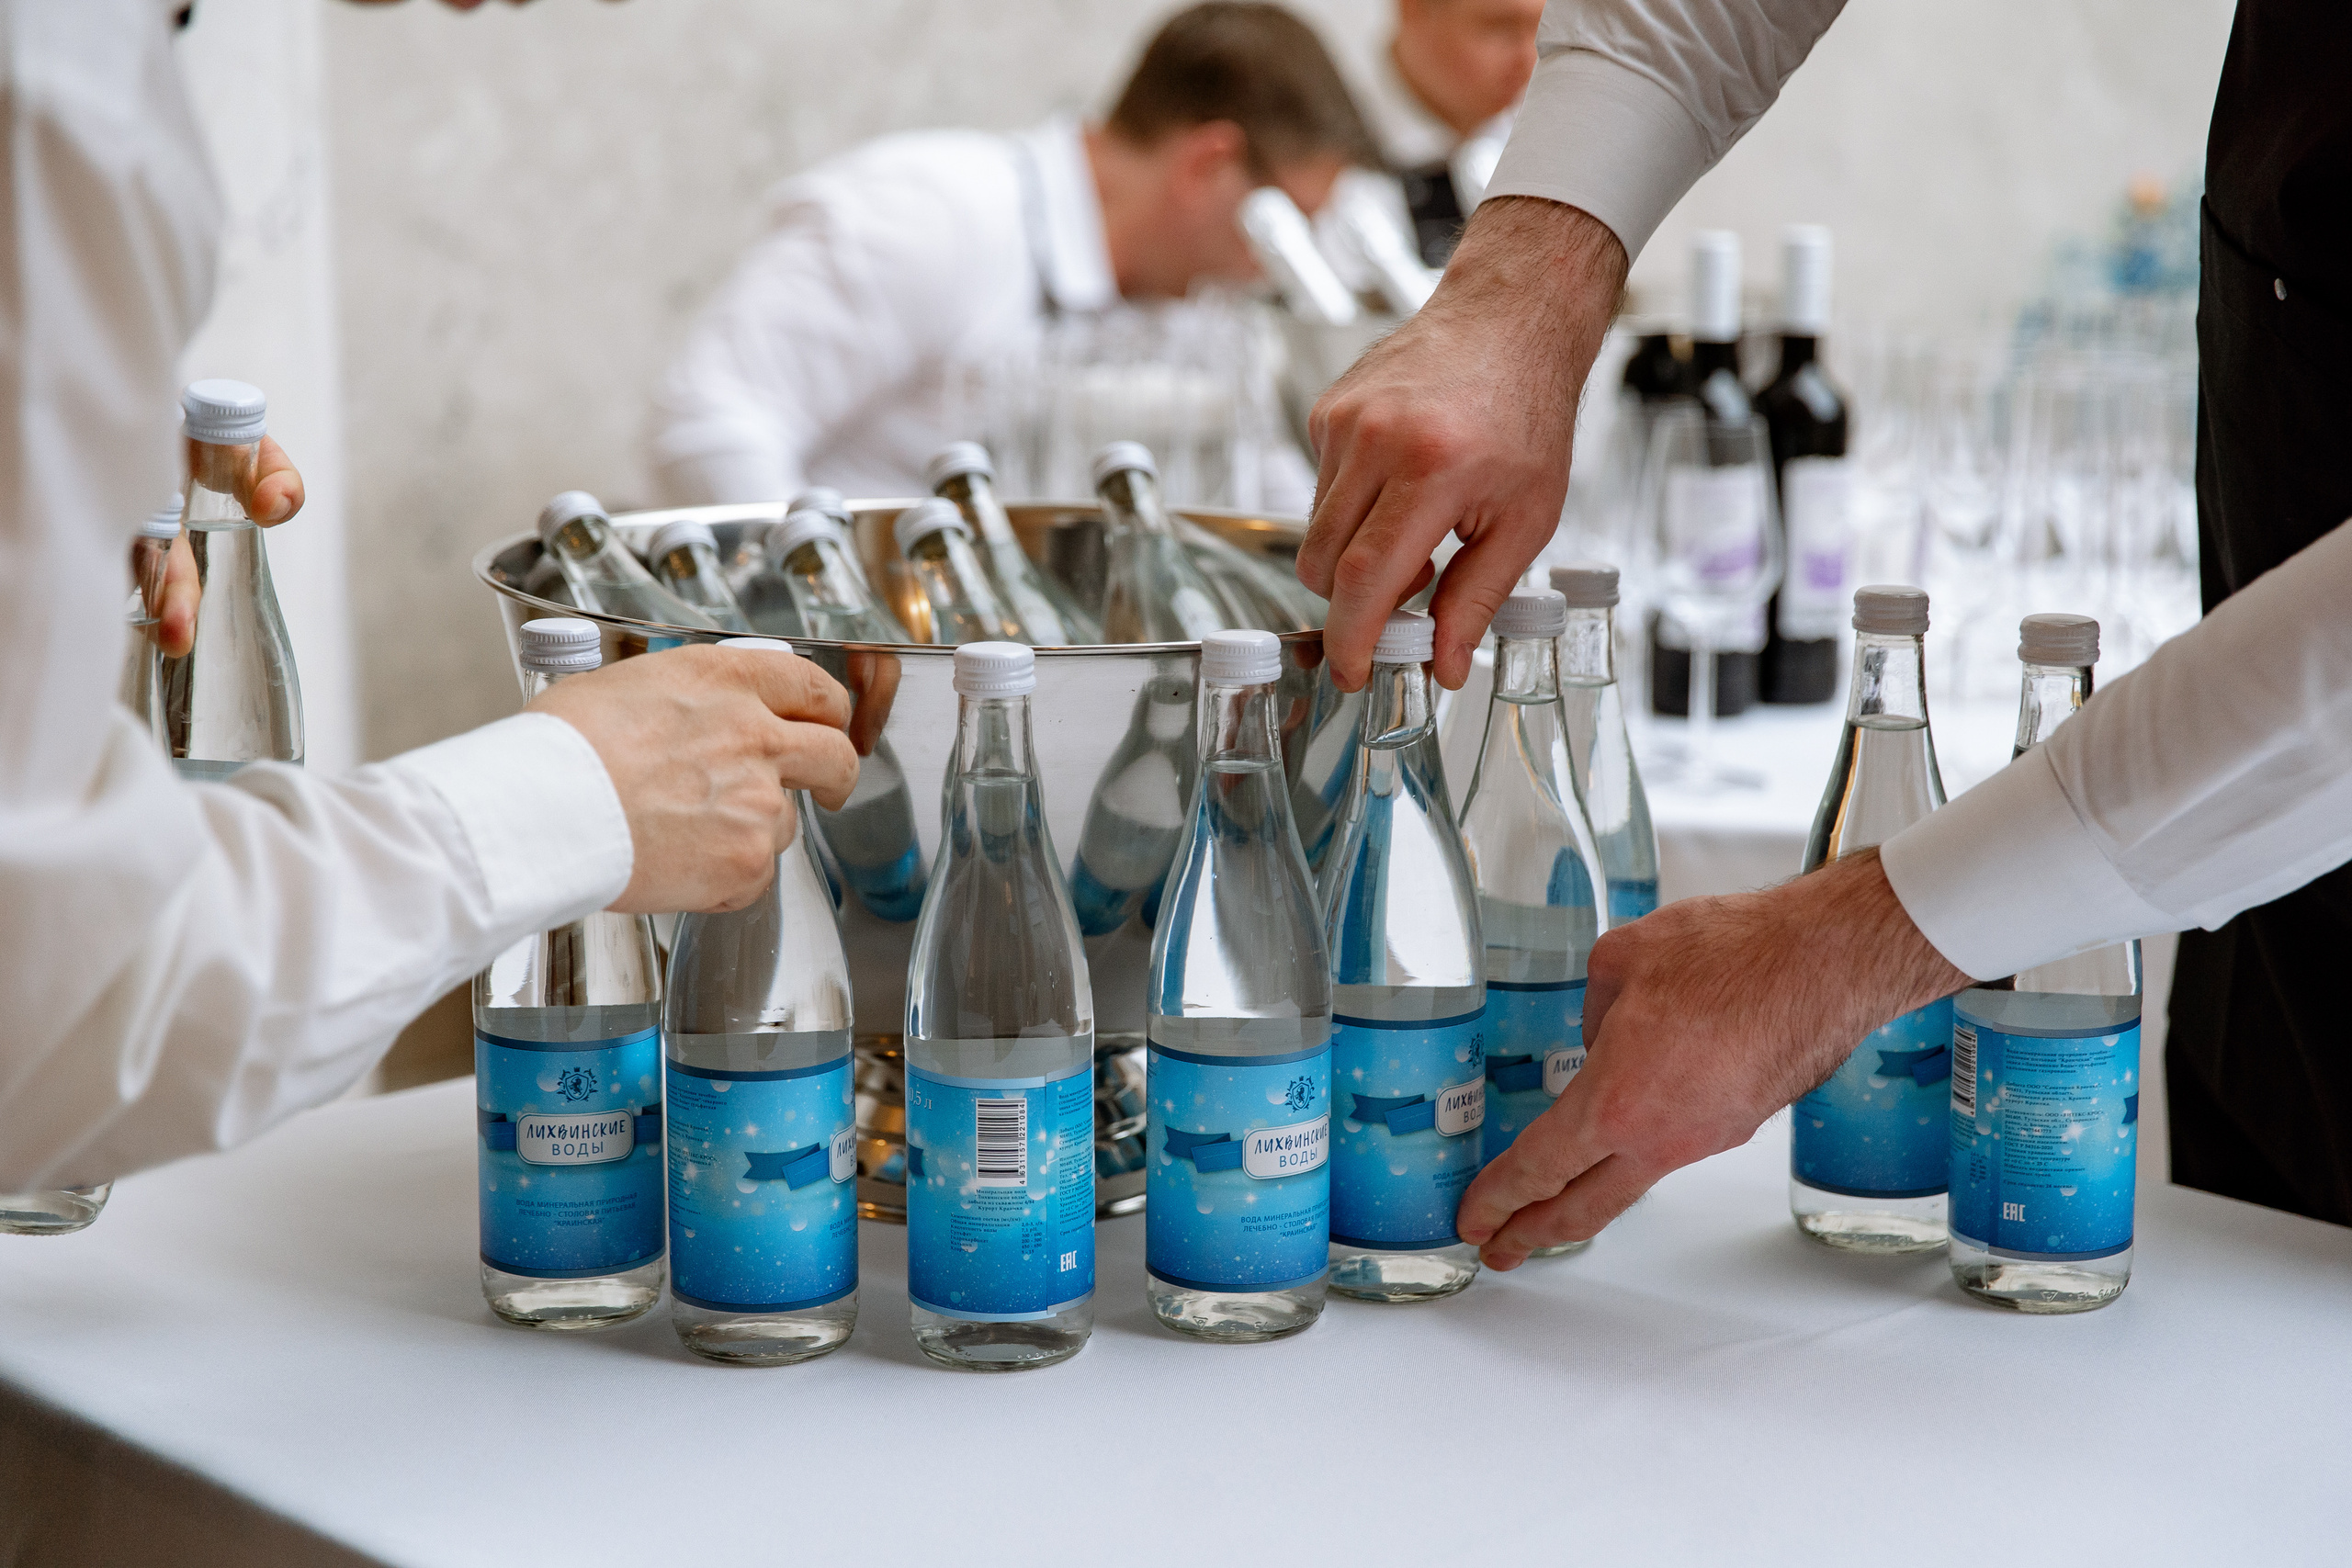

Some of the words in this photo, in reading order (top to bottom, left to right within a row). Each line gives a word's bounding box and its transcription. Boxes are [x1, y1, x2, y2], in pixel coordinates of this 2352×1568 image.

[924, 1098, 933, 1111] л
[526, 1119, 627, 1140] ЛИХВИНСКИЕ
[1254, 1122, 1329, 1155] ЛИХВИНСКИЕ
[551, 1141, 604, 1158] ВОДЫ
[1279, 1146, 1317, 1168] ВОДЫ
[515, 1199, 534, 1208] ВОДА
[537, 1200, 594, 1209] МИНЕРАЛЬНАЯ
[596, 1192, 639, 1206] ПРИРОДНАЯ
[518, 1208, 551, 1218] ЛЕЧЕБНО
[558, 1208, 600, 1218] СТОЛОВАЯ
[602, 1201, 636, 1214] ПИТЬЕВАЯ
[1240, 1214, 1262, 1224] ВОДА
[1263, 1206, 1311, 1223] МИНЕРАЛЬНАЯ
[1243, 1224, 1278, 1233] ЛЕЧЕБНО
[1283, 1214, 1315, 1230] СТОЛОВАЯ
